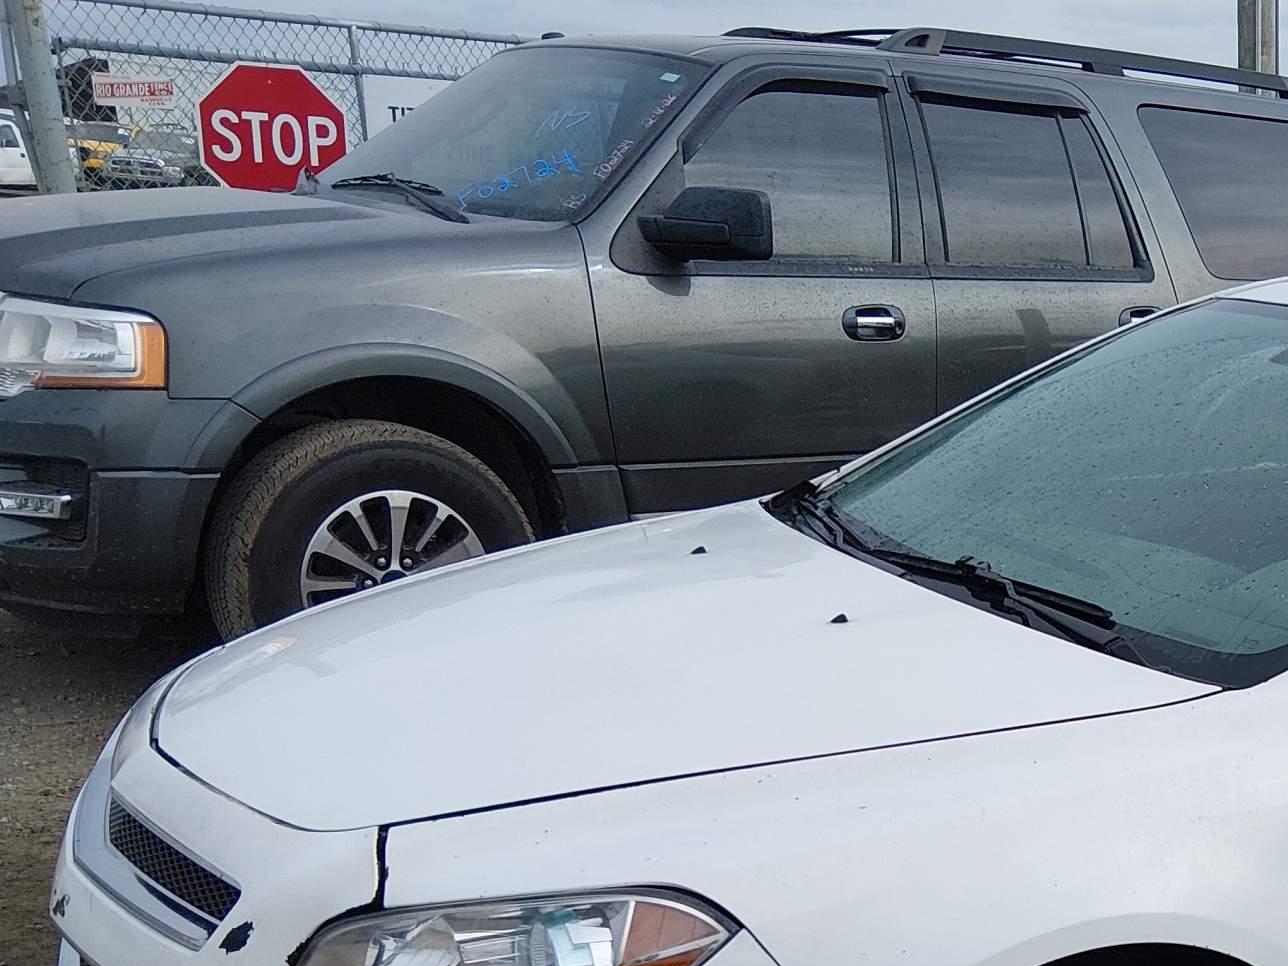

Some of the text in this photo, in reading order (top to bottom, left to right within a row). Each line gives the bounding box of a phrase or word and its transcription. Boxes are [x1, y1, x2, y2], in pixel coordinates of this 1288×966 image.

[95, 84, 112, 97] RIO
[113, 82, 150, 97] GRANDE
[211, 109, 338, 167] STOP
[456, 149, 580, 209] F02724
